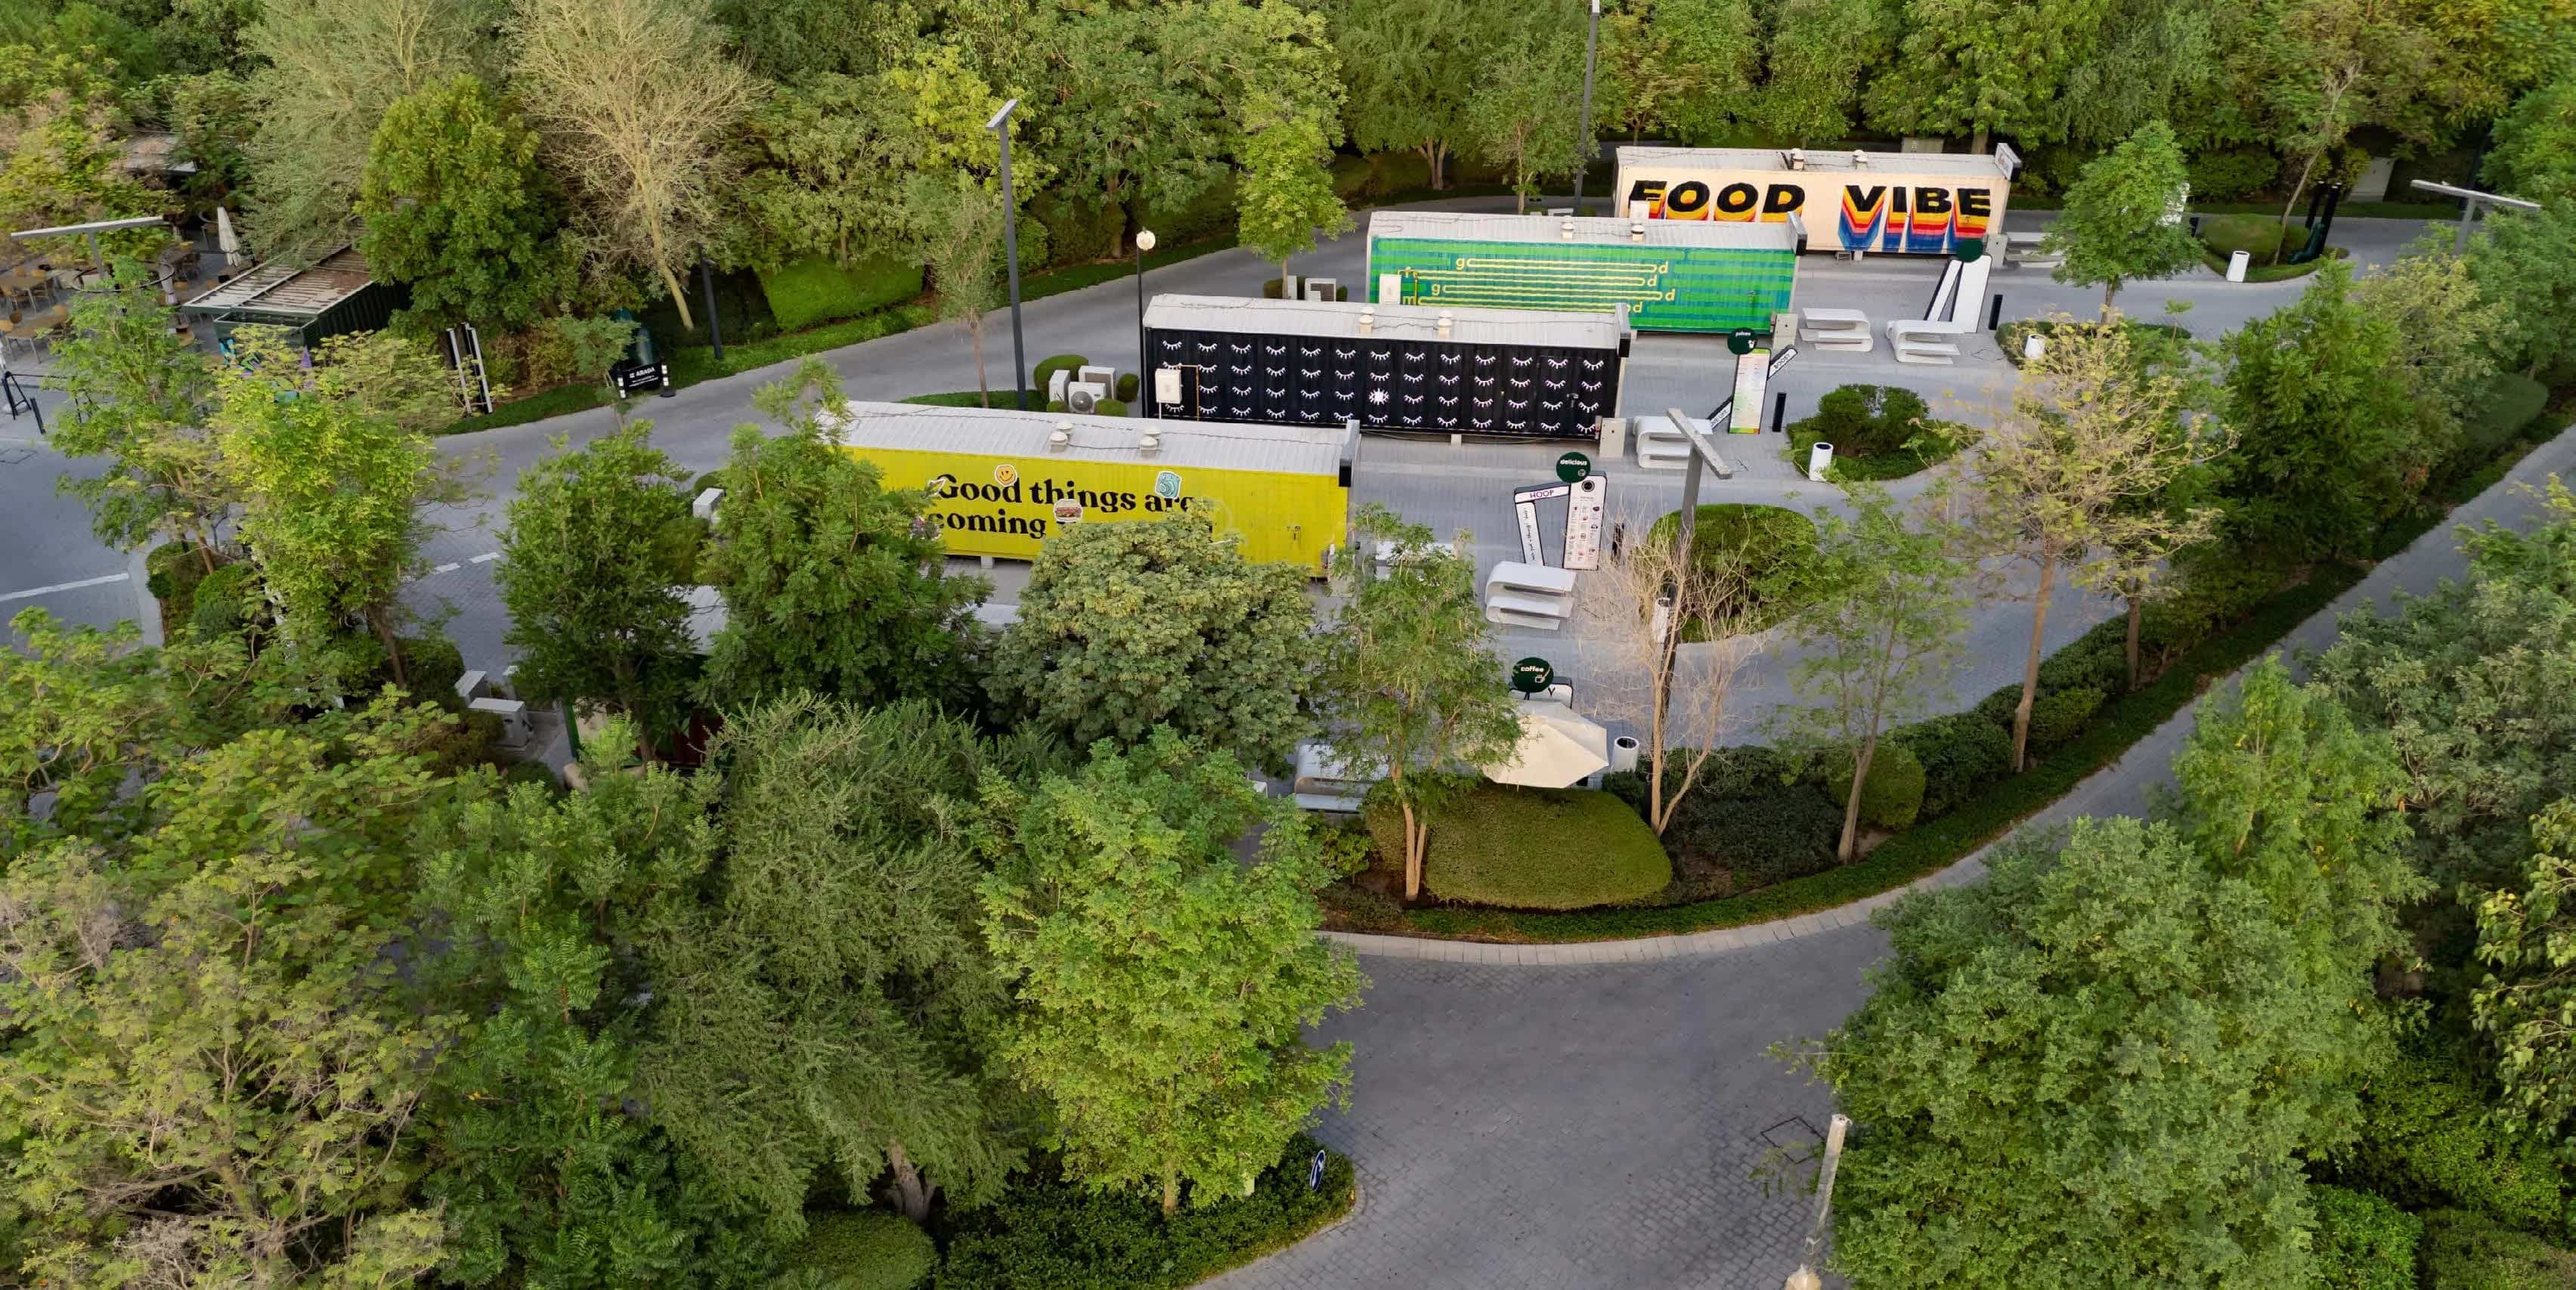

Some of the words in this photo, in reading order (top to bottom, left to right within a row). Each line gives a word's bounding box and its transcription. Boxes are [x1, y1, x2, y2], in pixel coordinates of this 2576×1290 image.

[1628, 180, 1806, 213] FOOD
[937, 473, 1023, 503] Good
[1029, 478, 1136, 513] things
[1529, 489, 1554, 498] HOOP
[927, 508, 1046, 539] coming
